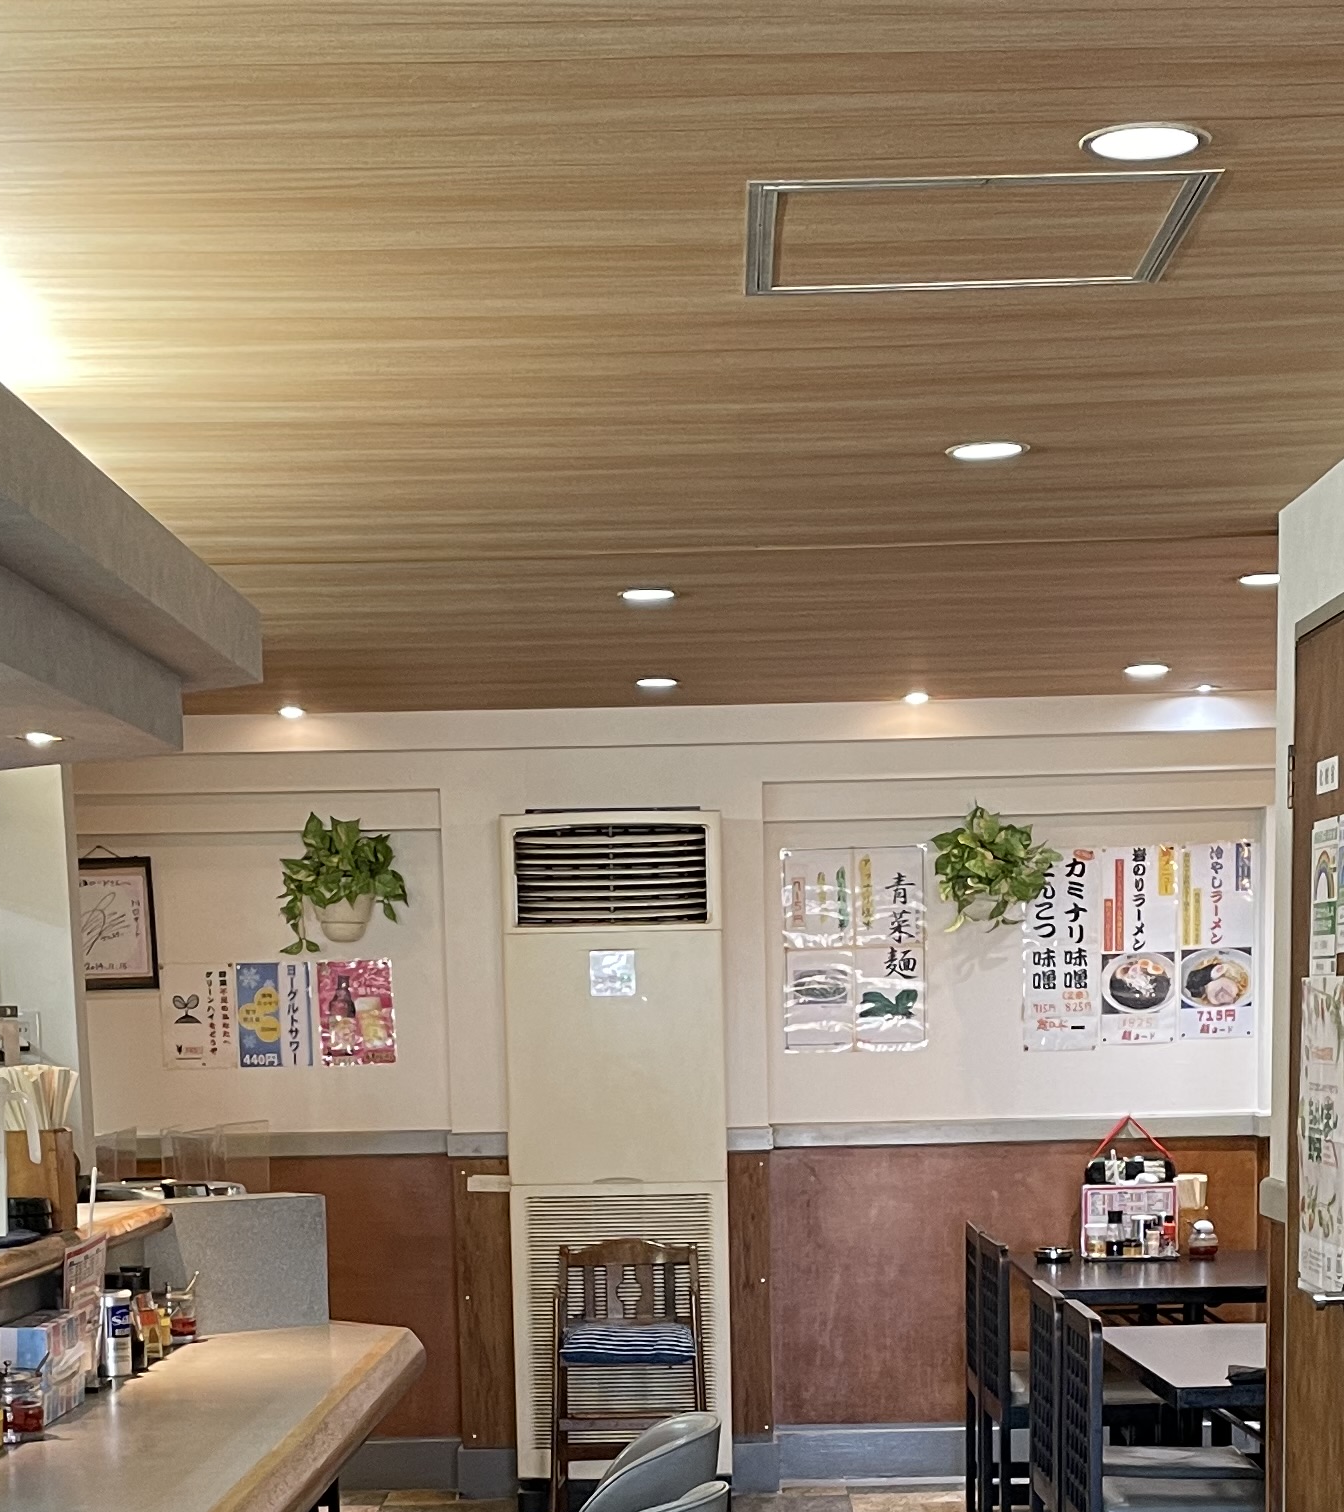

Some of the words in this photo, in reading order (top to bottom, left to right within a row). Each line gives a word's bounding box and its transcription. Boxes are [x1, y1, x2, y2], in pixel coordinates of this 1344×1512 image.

[884, 872, 918, 980] 青菜麺
[1032, 862, 1056, 990] んこつ味噌
[1064, 858, 1088, 989] カミナリ味噌
[1132, 847, 1147, 951] 岩のりラーメン
[1209, 846, 1224, 944] 冷やしラーメン
[205, 971, 218, 1056] グリーンハイをどうぞ
[243, 1053, 279, 1066] 440円
[286, 964, 300, 1066] ヨーグルトサワー
[1197, 1009, 1236, 1022] 715円
